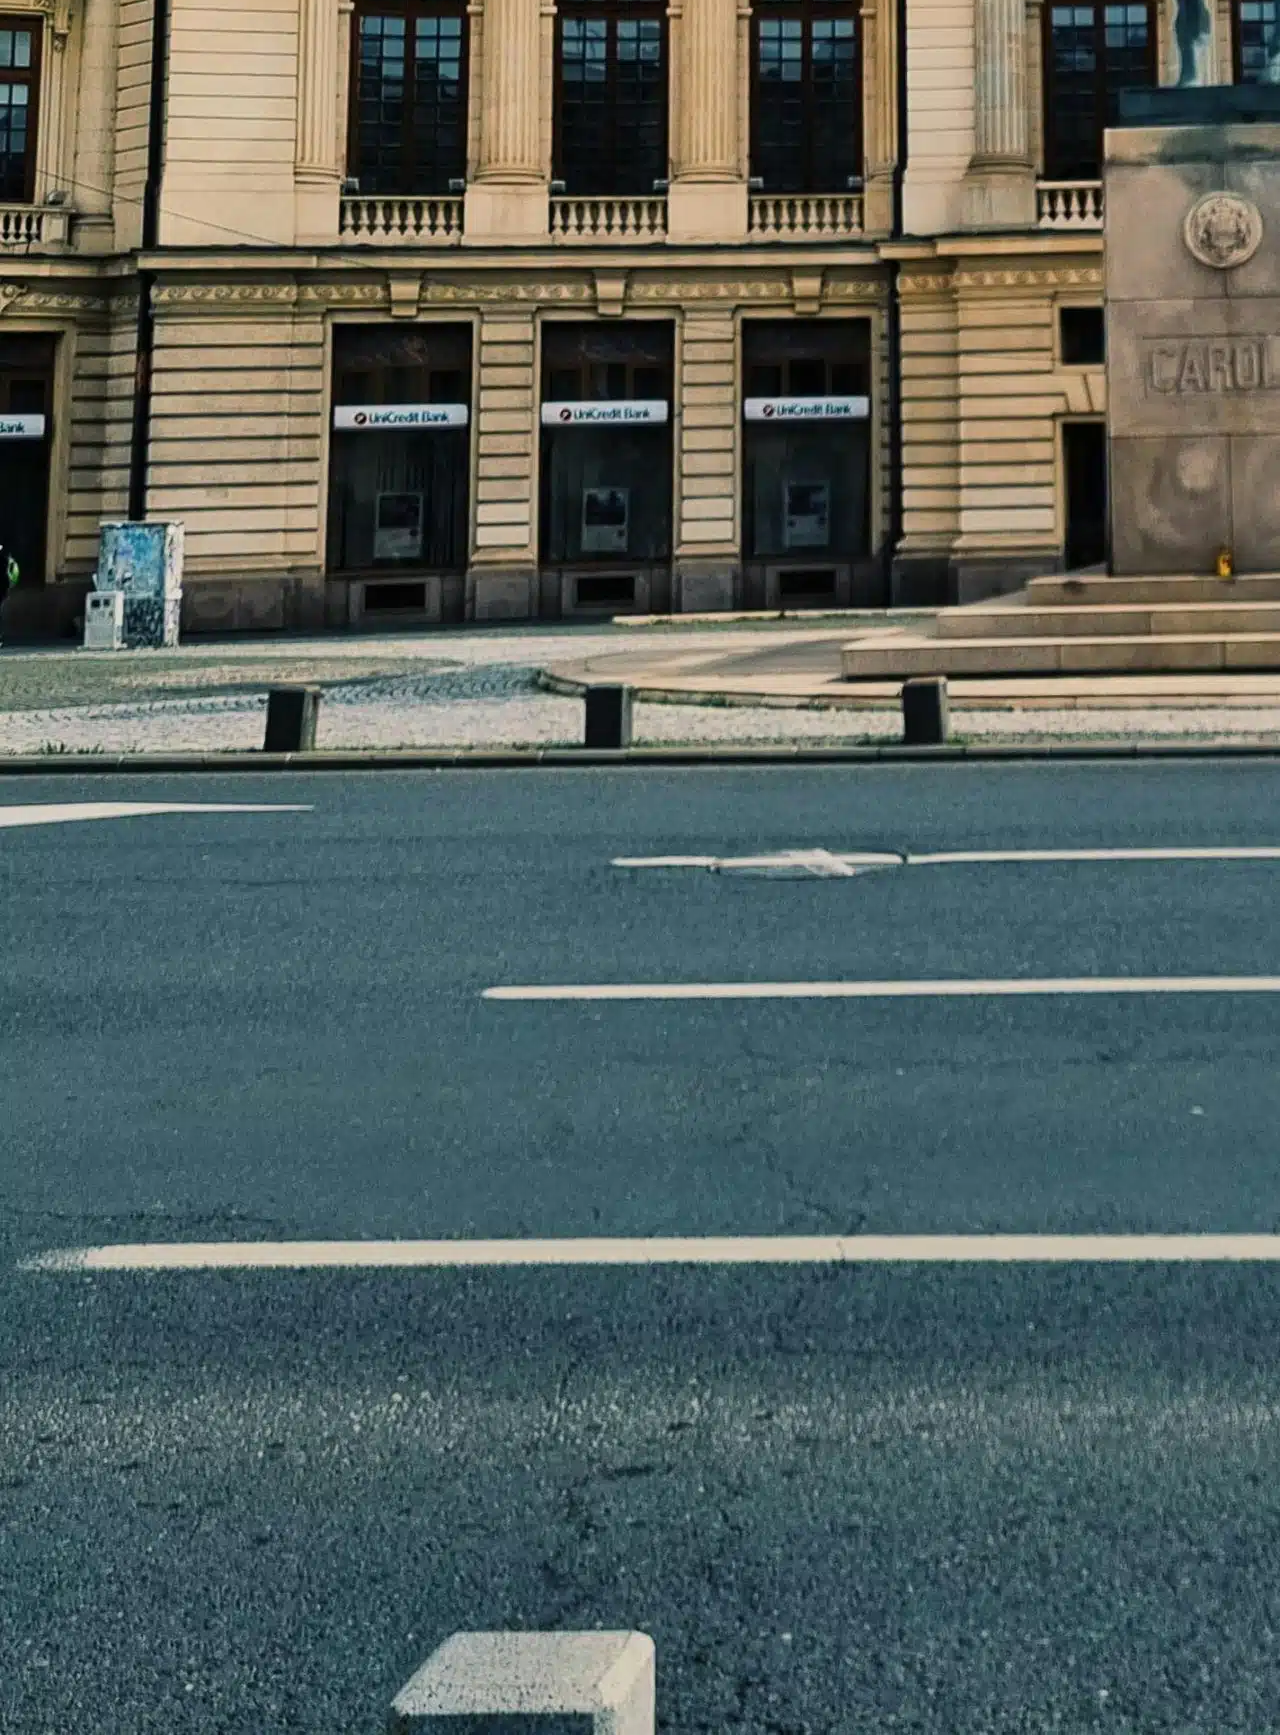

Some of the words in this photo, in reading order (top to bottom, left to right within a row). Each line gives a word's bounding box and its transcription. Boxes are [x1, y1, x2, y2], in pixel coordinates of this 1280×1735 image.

[1148, 343, 1280, 394] CAROL
[369, 411, 419, 424] UniCredit
[422, 409, 449, 423] Bank
[574, 408, 621, 420] UniCredit
[624, 408, 650, 420] Bank
[776, 403, 823, 416] UniCredit
[825, 403, 851, 415] Bank
